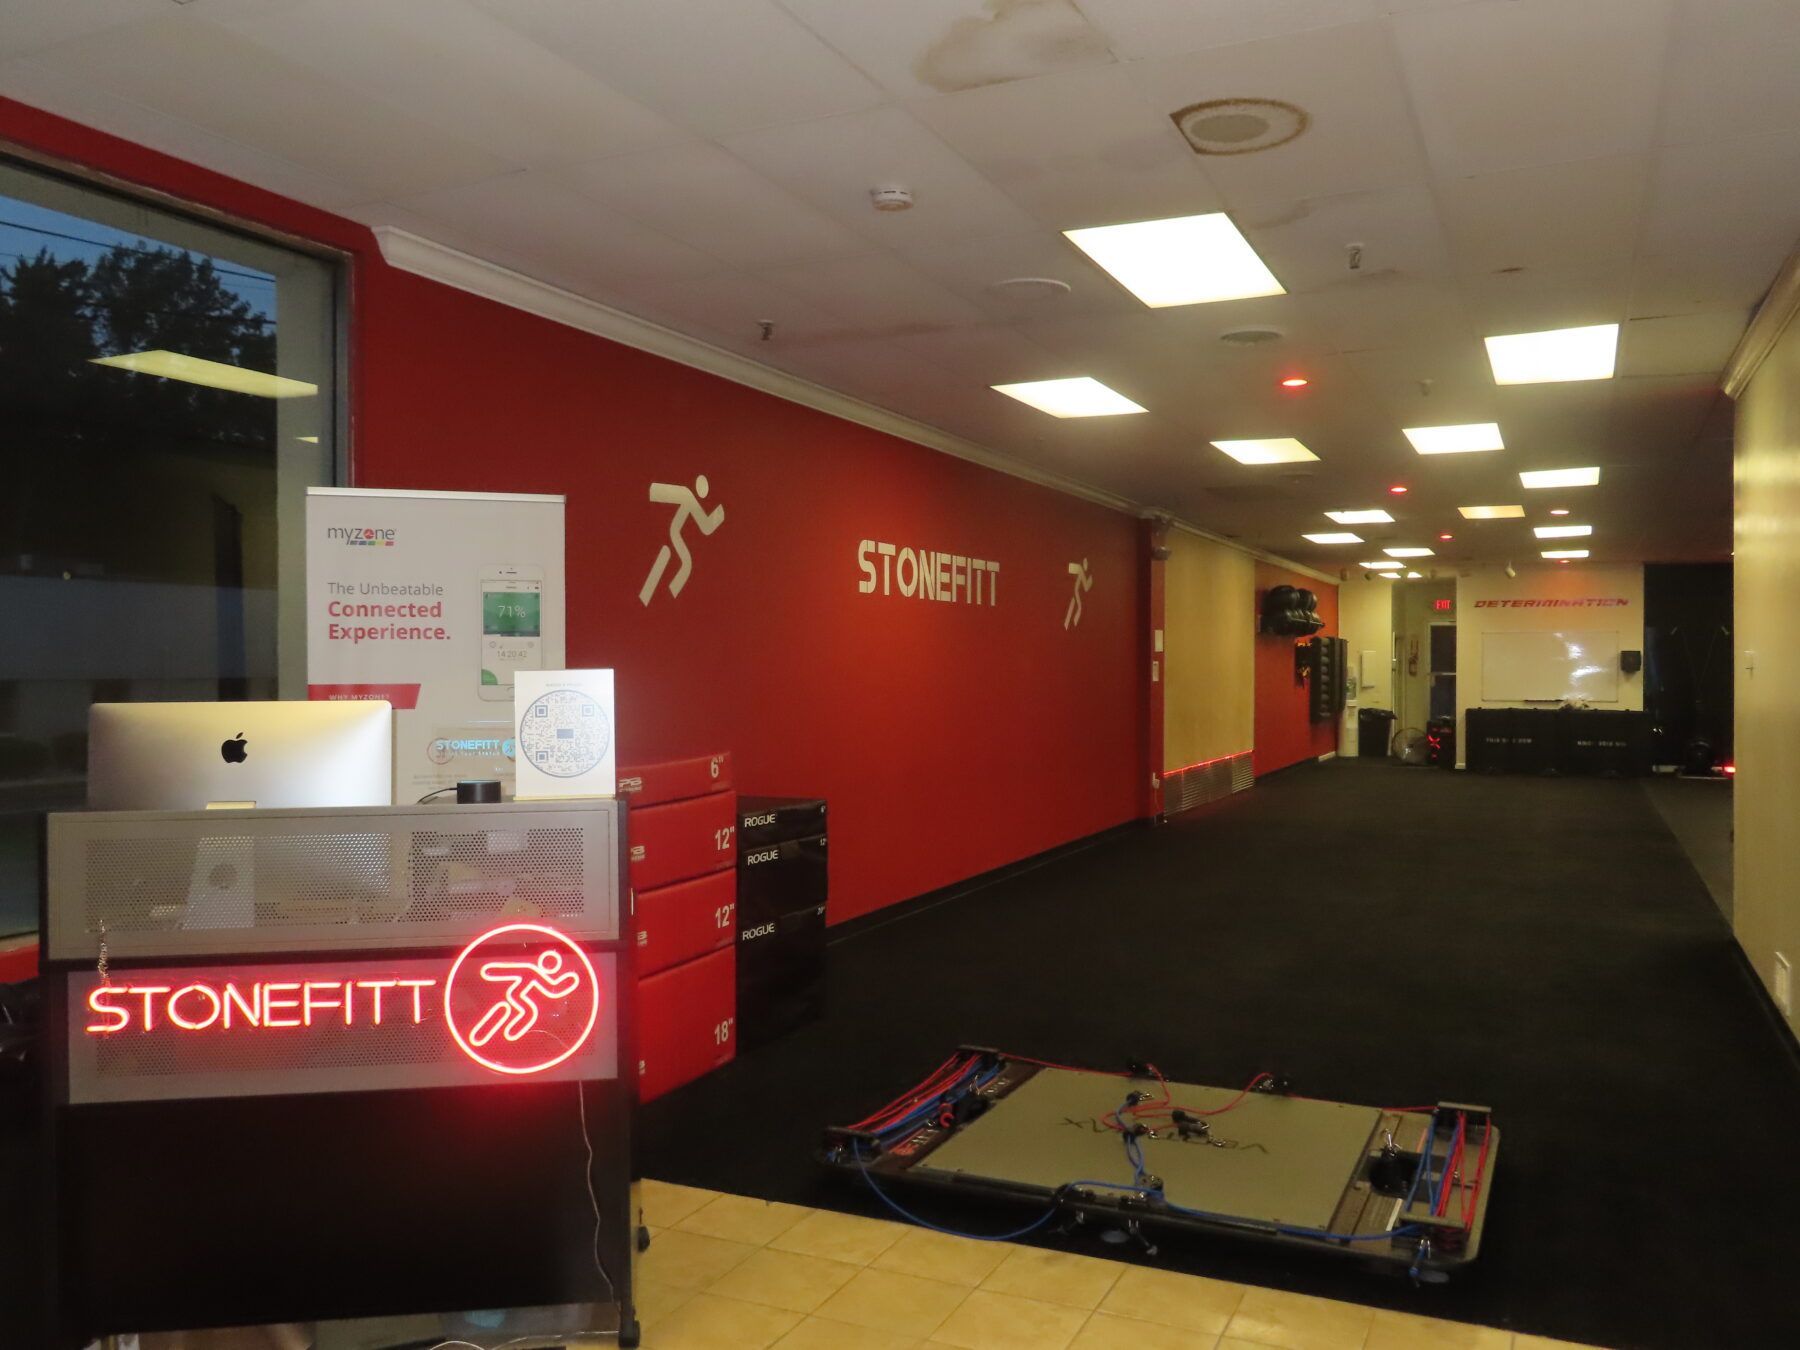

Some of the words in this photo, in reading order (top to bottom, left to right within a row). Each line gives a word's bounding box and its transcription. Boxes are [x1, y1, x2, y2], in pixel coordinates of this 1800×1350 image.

[327, 527, 396, 545] myzone
[858, 539, 1000, 606] STONEFITT
[327, 582, 355, 595] The
[360, 582, 444, 596] Unbeatable
[328, 601, 442, 618] Connected
[498, 605, 526, 618] 71%
[1475, 598, 1629, 608] DETERMINATION
[329, 623, 451, 644] Experience.
[435, 739, 500, 751] STONEFITT
[744, 813, 776, 827] ROGUE
[715, 826, 735, 850] 12"
[747, 849, 779, 866] ROGUE
[715, 903, 735, 928] 12"
[742, 923, 775, 941] ROGUE
[86, 979, 436, 1032] STONEFITT
[715, 1017, 733, 1045] 18"
